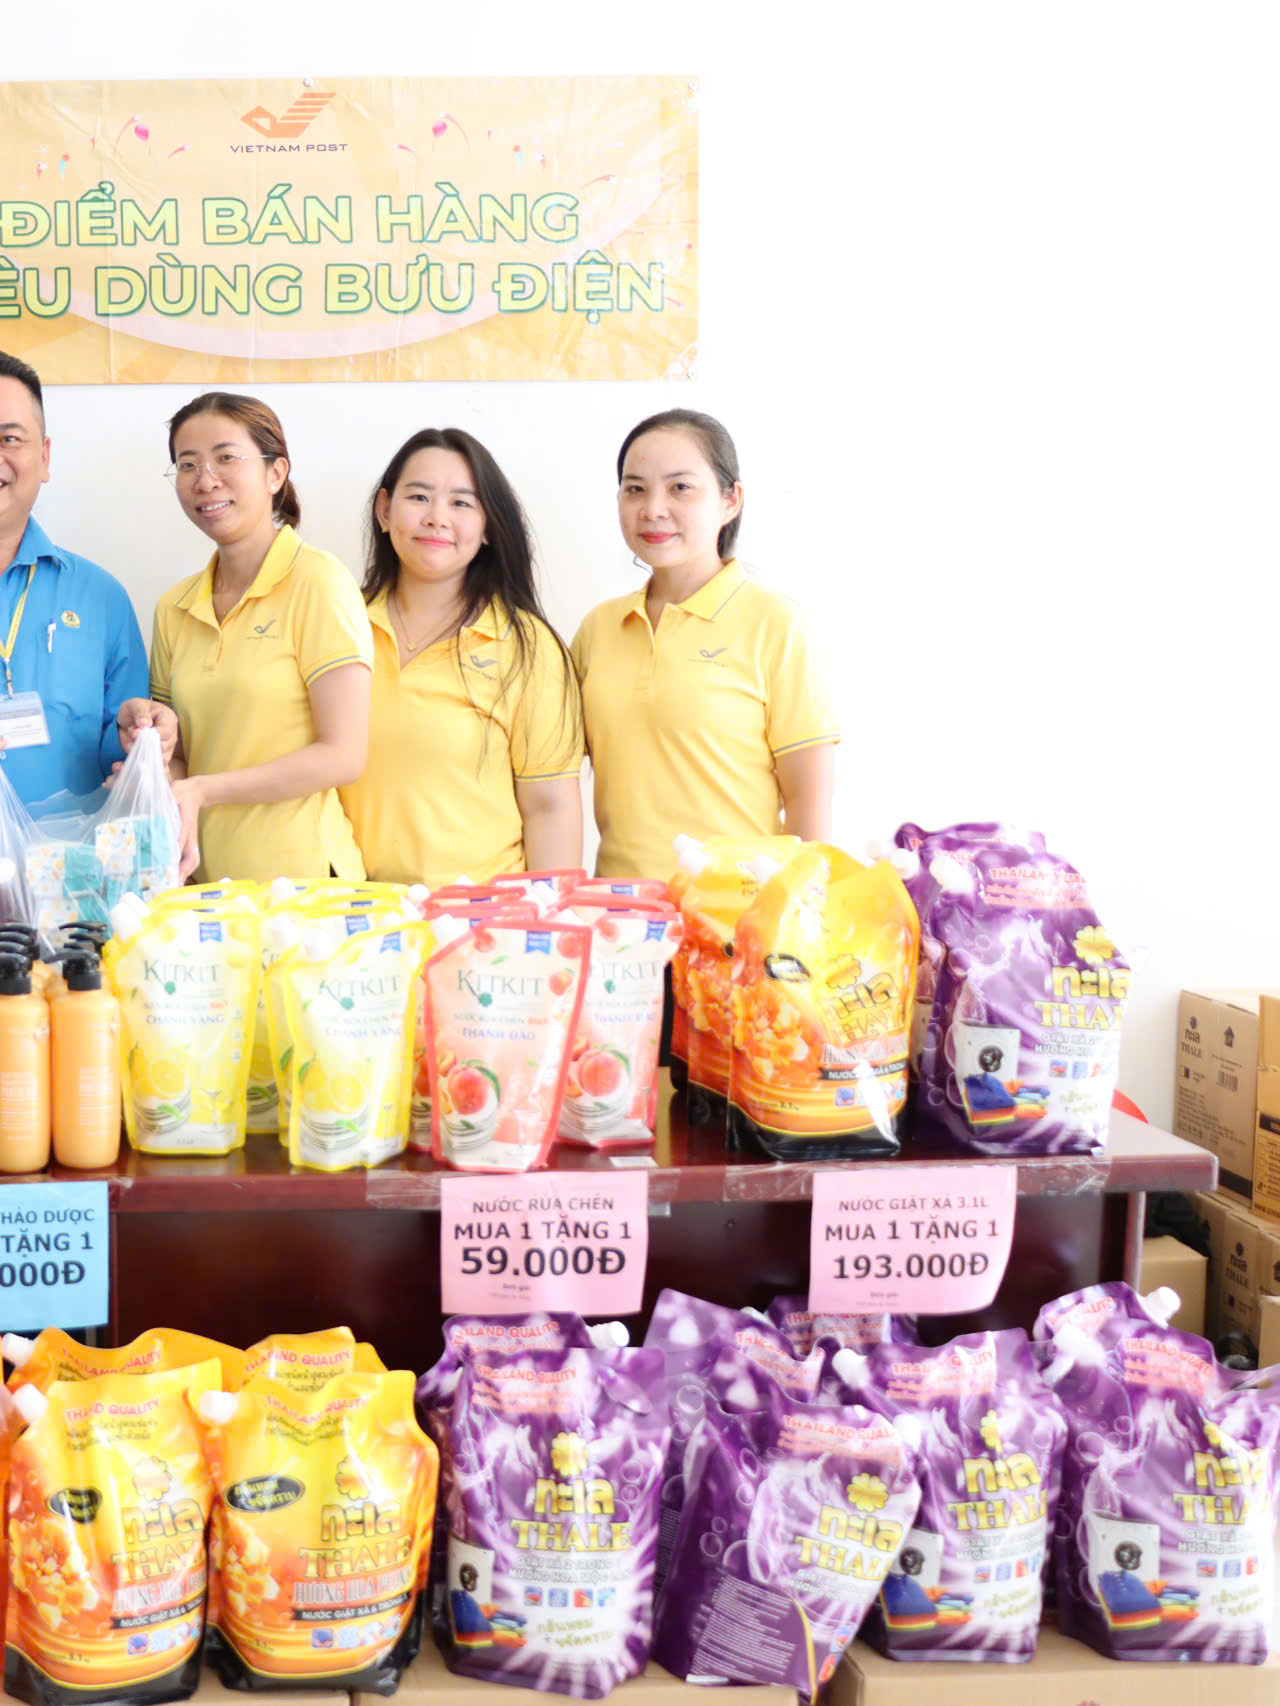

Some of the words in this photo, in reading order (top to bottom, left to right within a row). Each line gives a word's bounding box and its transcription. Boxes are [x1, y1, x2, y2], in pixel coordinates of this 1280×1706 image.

[230, 143, 301, 154] VIETNAM
[306, 142, 348, 153] POST
[201, 183, 354, 246] BÁN
[375, 181, 580, 244] HÀNG
[94, 253, 302, 319] DÙNG
[325, 260, 477, 315] BƯU
[491, 249, 665, 325] ĐIỆN
[44, 1207, 96, 1226] DƯỢC
[473, 1195, 522, 1213] NƯỚC
[568, 1193, 614, 1211] CHÉN
[958, 1196, 989, 1209] 3.1L
[0, 1228, 70, 1258] TẶNG
[81, 1232, 94, 1250] 1
[454, 1222, 511, 1241] MUA
[521, 1222, 532, 1239] 1
[542, 1214, 609, 1243] TẶNG
[620, 1221, 632, 1239] 1
[825, 1224, 876, 1241] MUA
[887, 1220, 900, 1240] 1
[909, 1215, 978, 1244] TẶNG
[987, 1220, 999, 1237] 1
[461, 1246, 626, 1277] 59.000Đ
[833, 1252, 989, 1279] 193.000Đ
[509, 1321, 560, 1338] QUALITY
[108, 1399, 159, 1415] QUALITY
[510, 1518, 633, 1552] THALE
[300, 1535, 413, 1580] THALE
